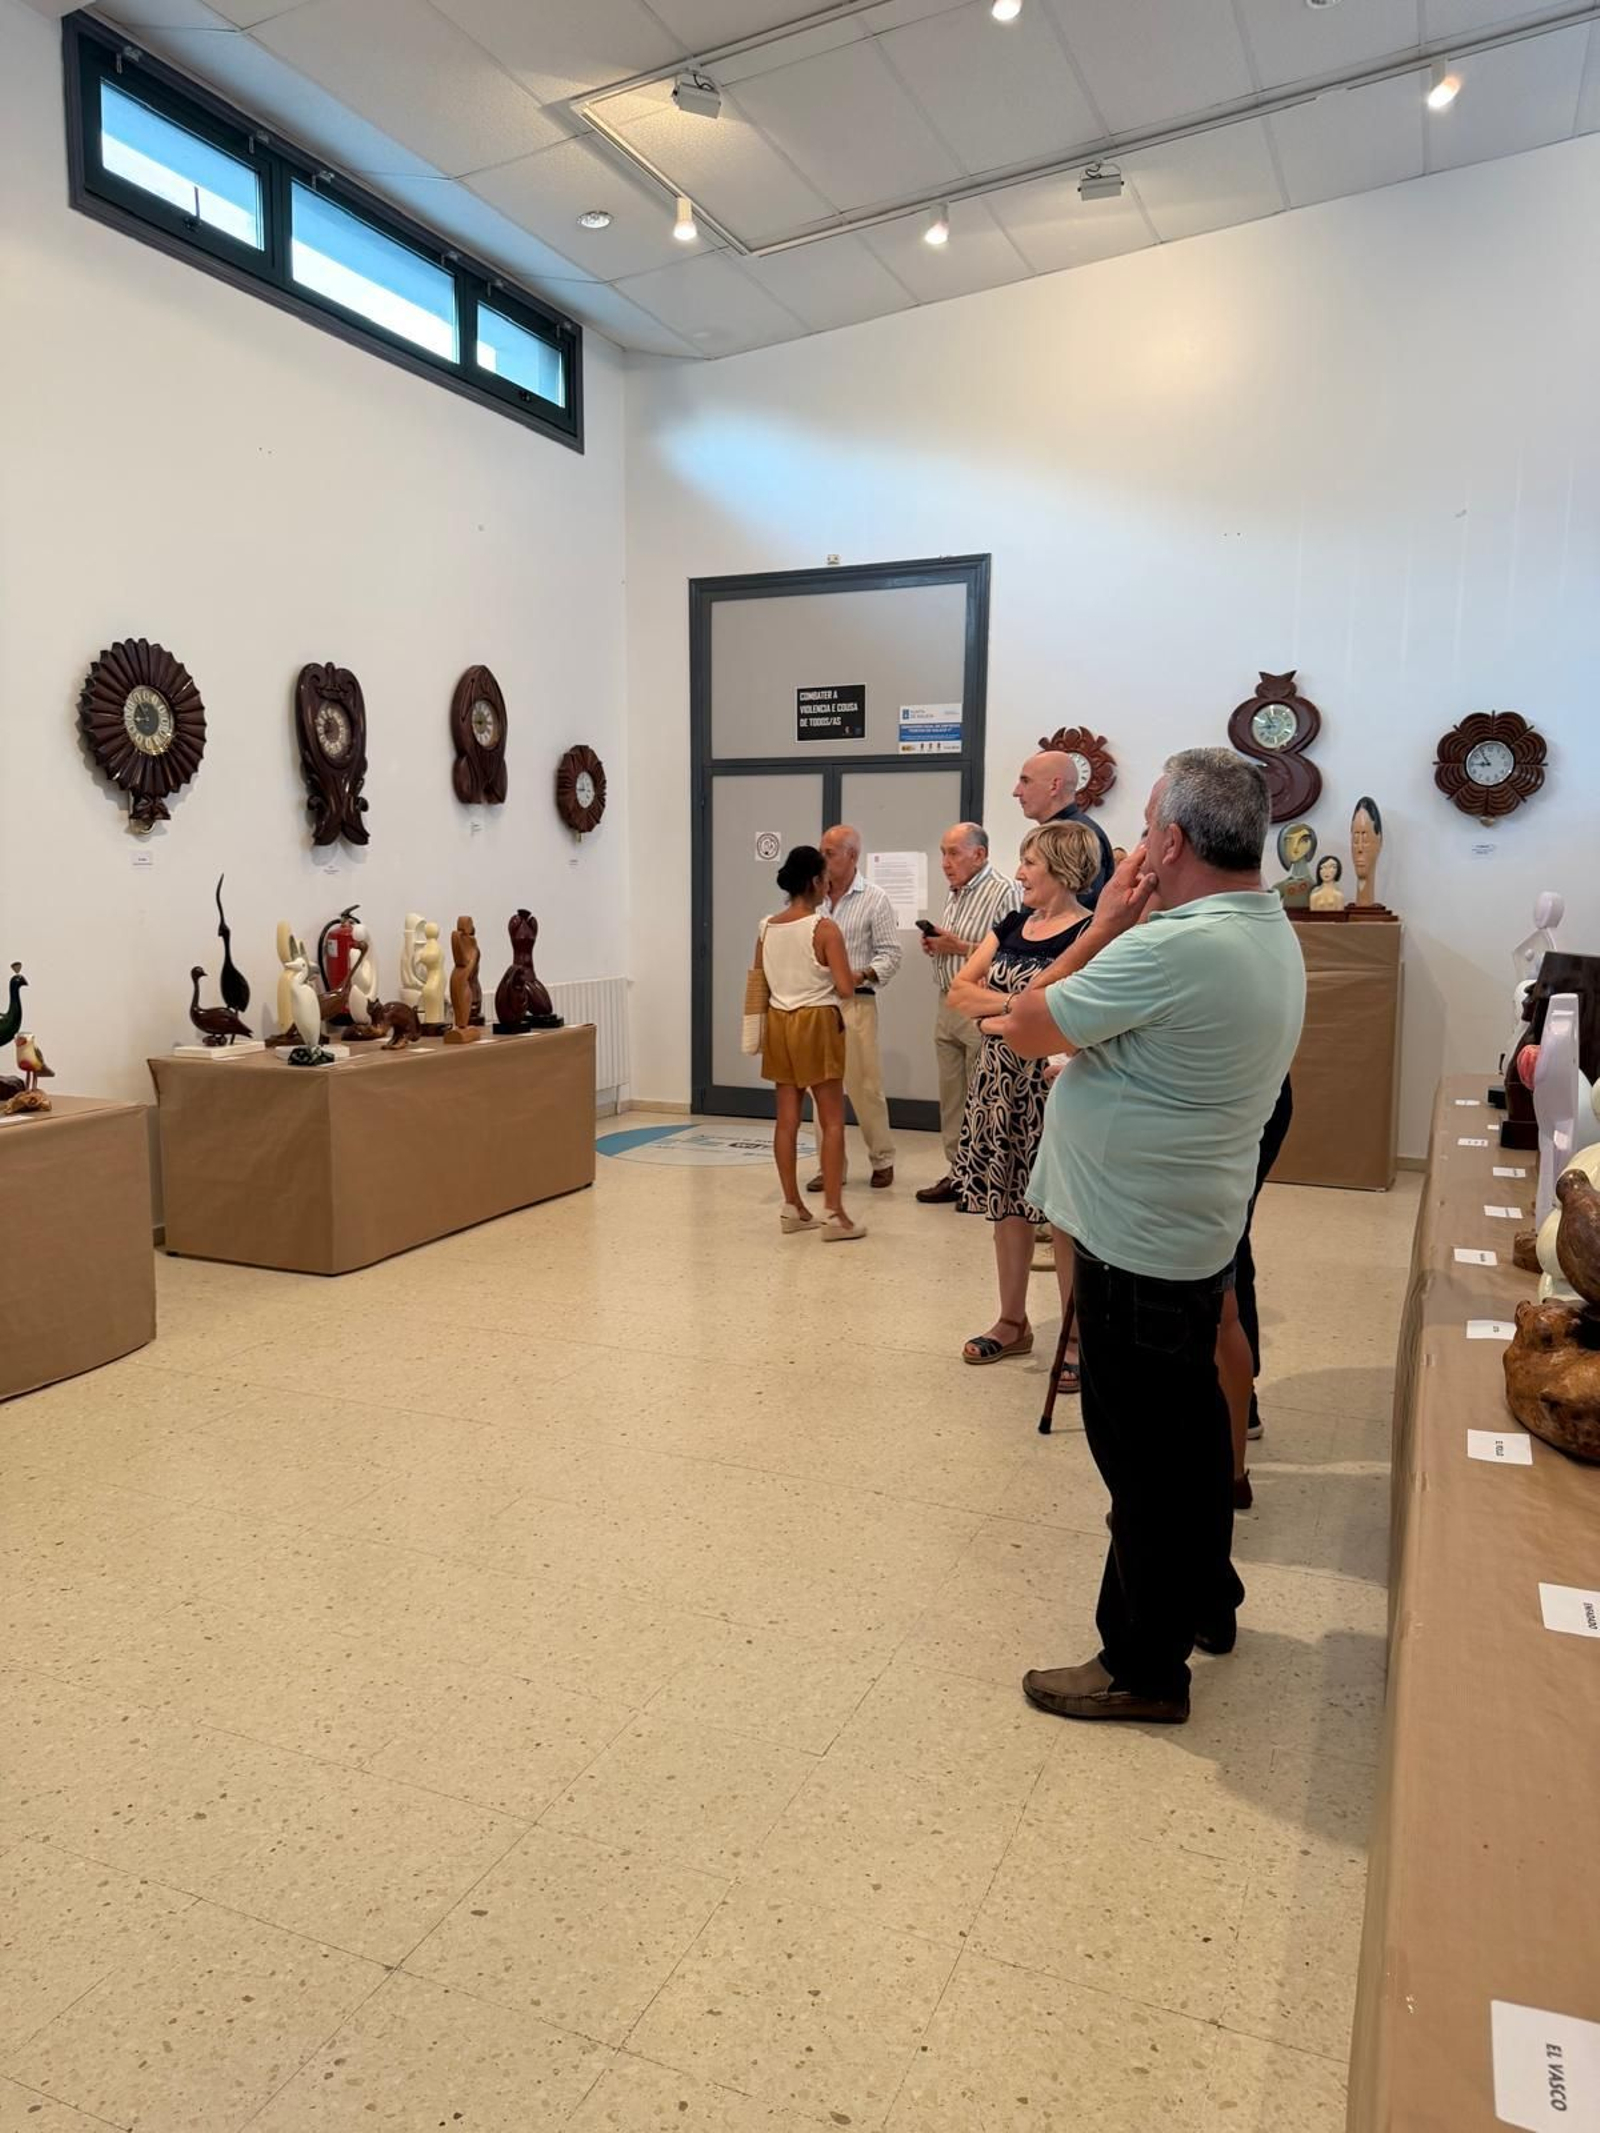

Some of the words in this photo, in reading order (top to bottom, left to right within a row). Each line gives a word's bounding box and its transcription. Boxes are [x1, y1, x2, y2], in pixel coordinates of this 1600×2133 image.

[799, 690, 832, 701] COMBATER
[833, 690, 838, 699] A
[799, 704, 830, 714] VIOLENCIA
[837, 702, 858, 712] COUSA
[799, 718, 808, 727] DE
[809, 716, 842, 726] TODOS/AS
[1546, 2043, 1562, 2058] EL
[1548, 2064, 1567, 2112] VASCO
